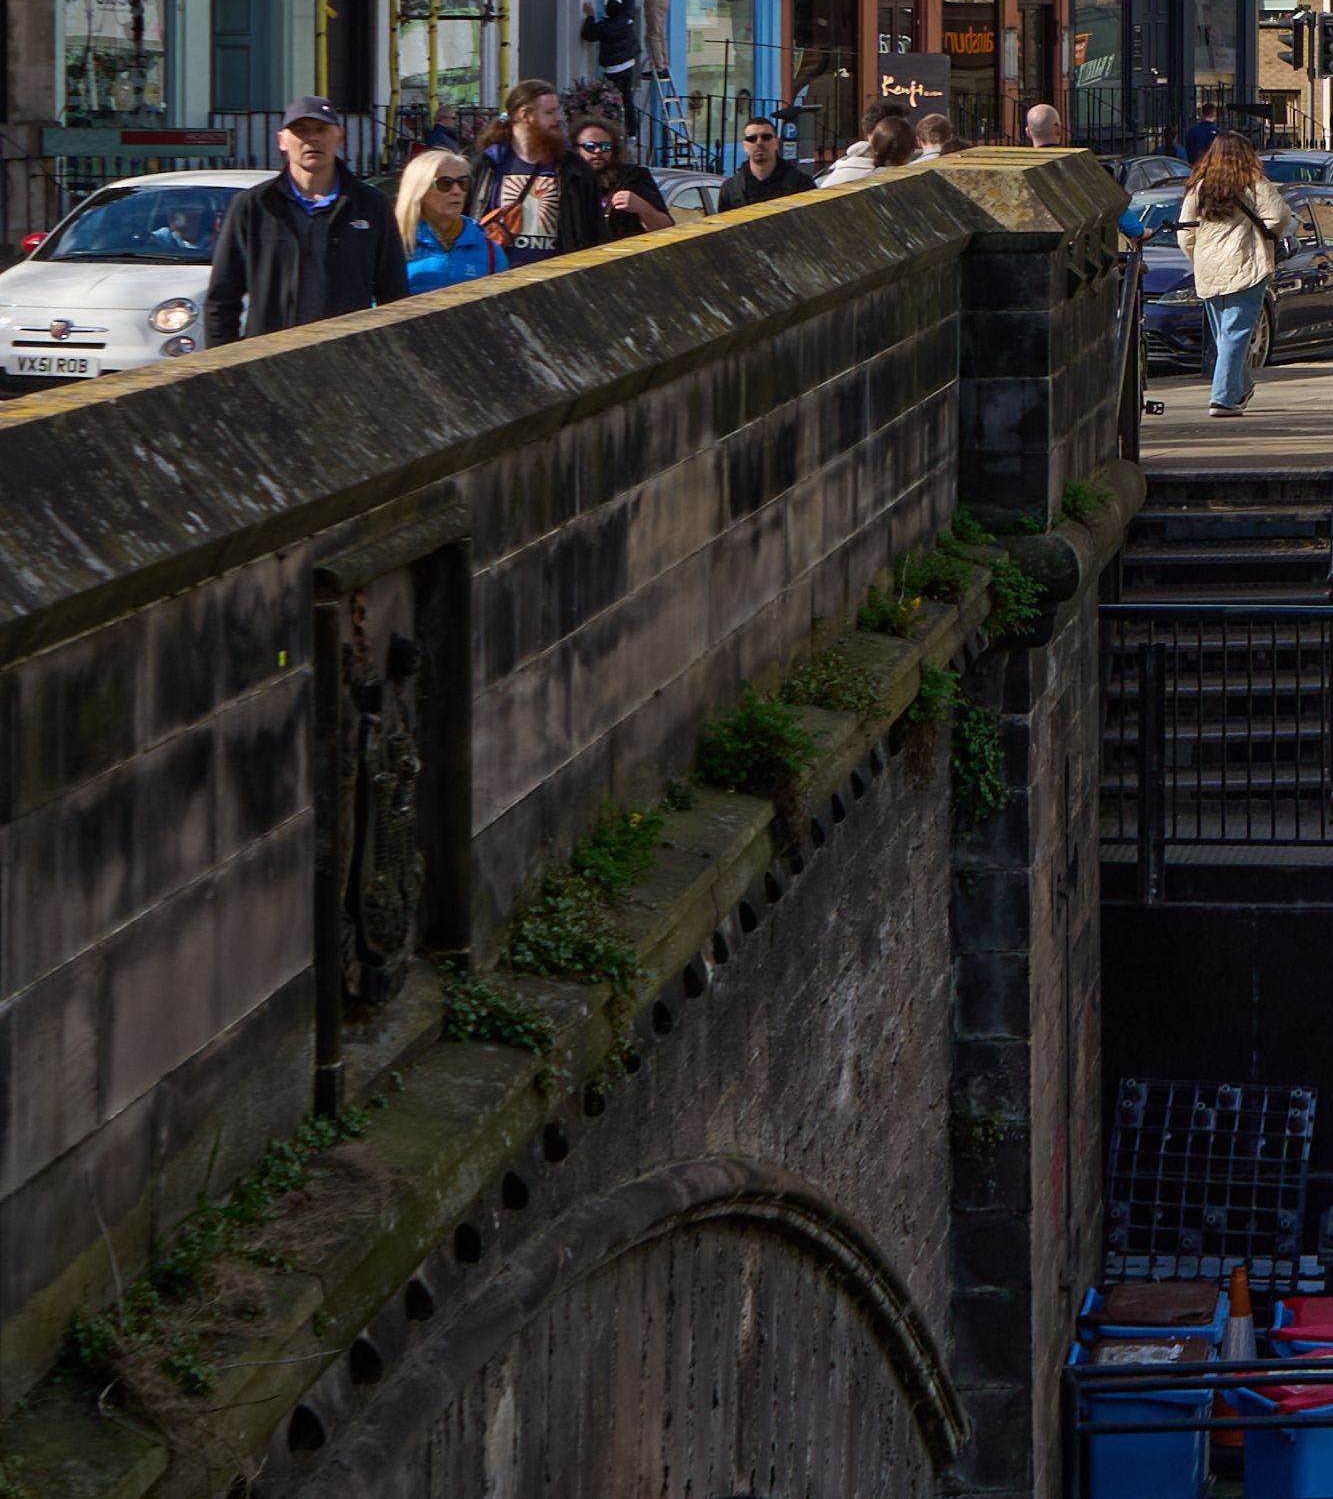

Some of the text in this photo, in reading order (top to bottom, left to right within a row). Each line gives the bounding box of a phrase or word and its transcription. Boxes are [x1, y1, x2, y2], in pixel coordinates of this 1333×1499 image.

[881, 74, 923, 108] Kenji
[509, 236, 556, 250] ONK
[17, 356, 88, 374] VX51 ROB
